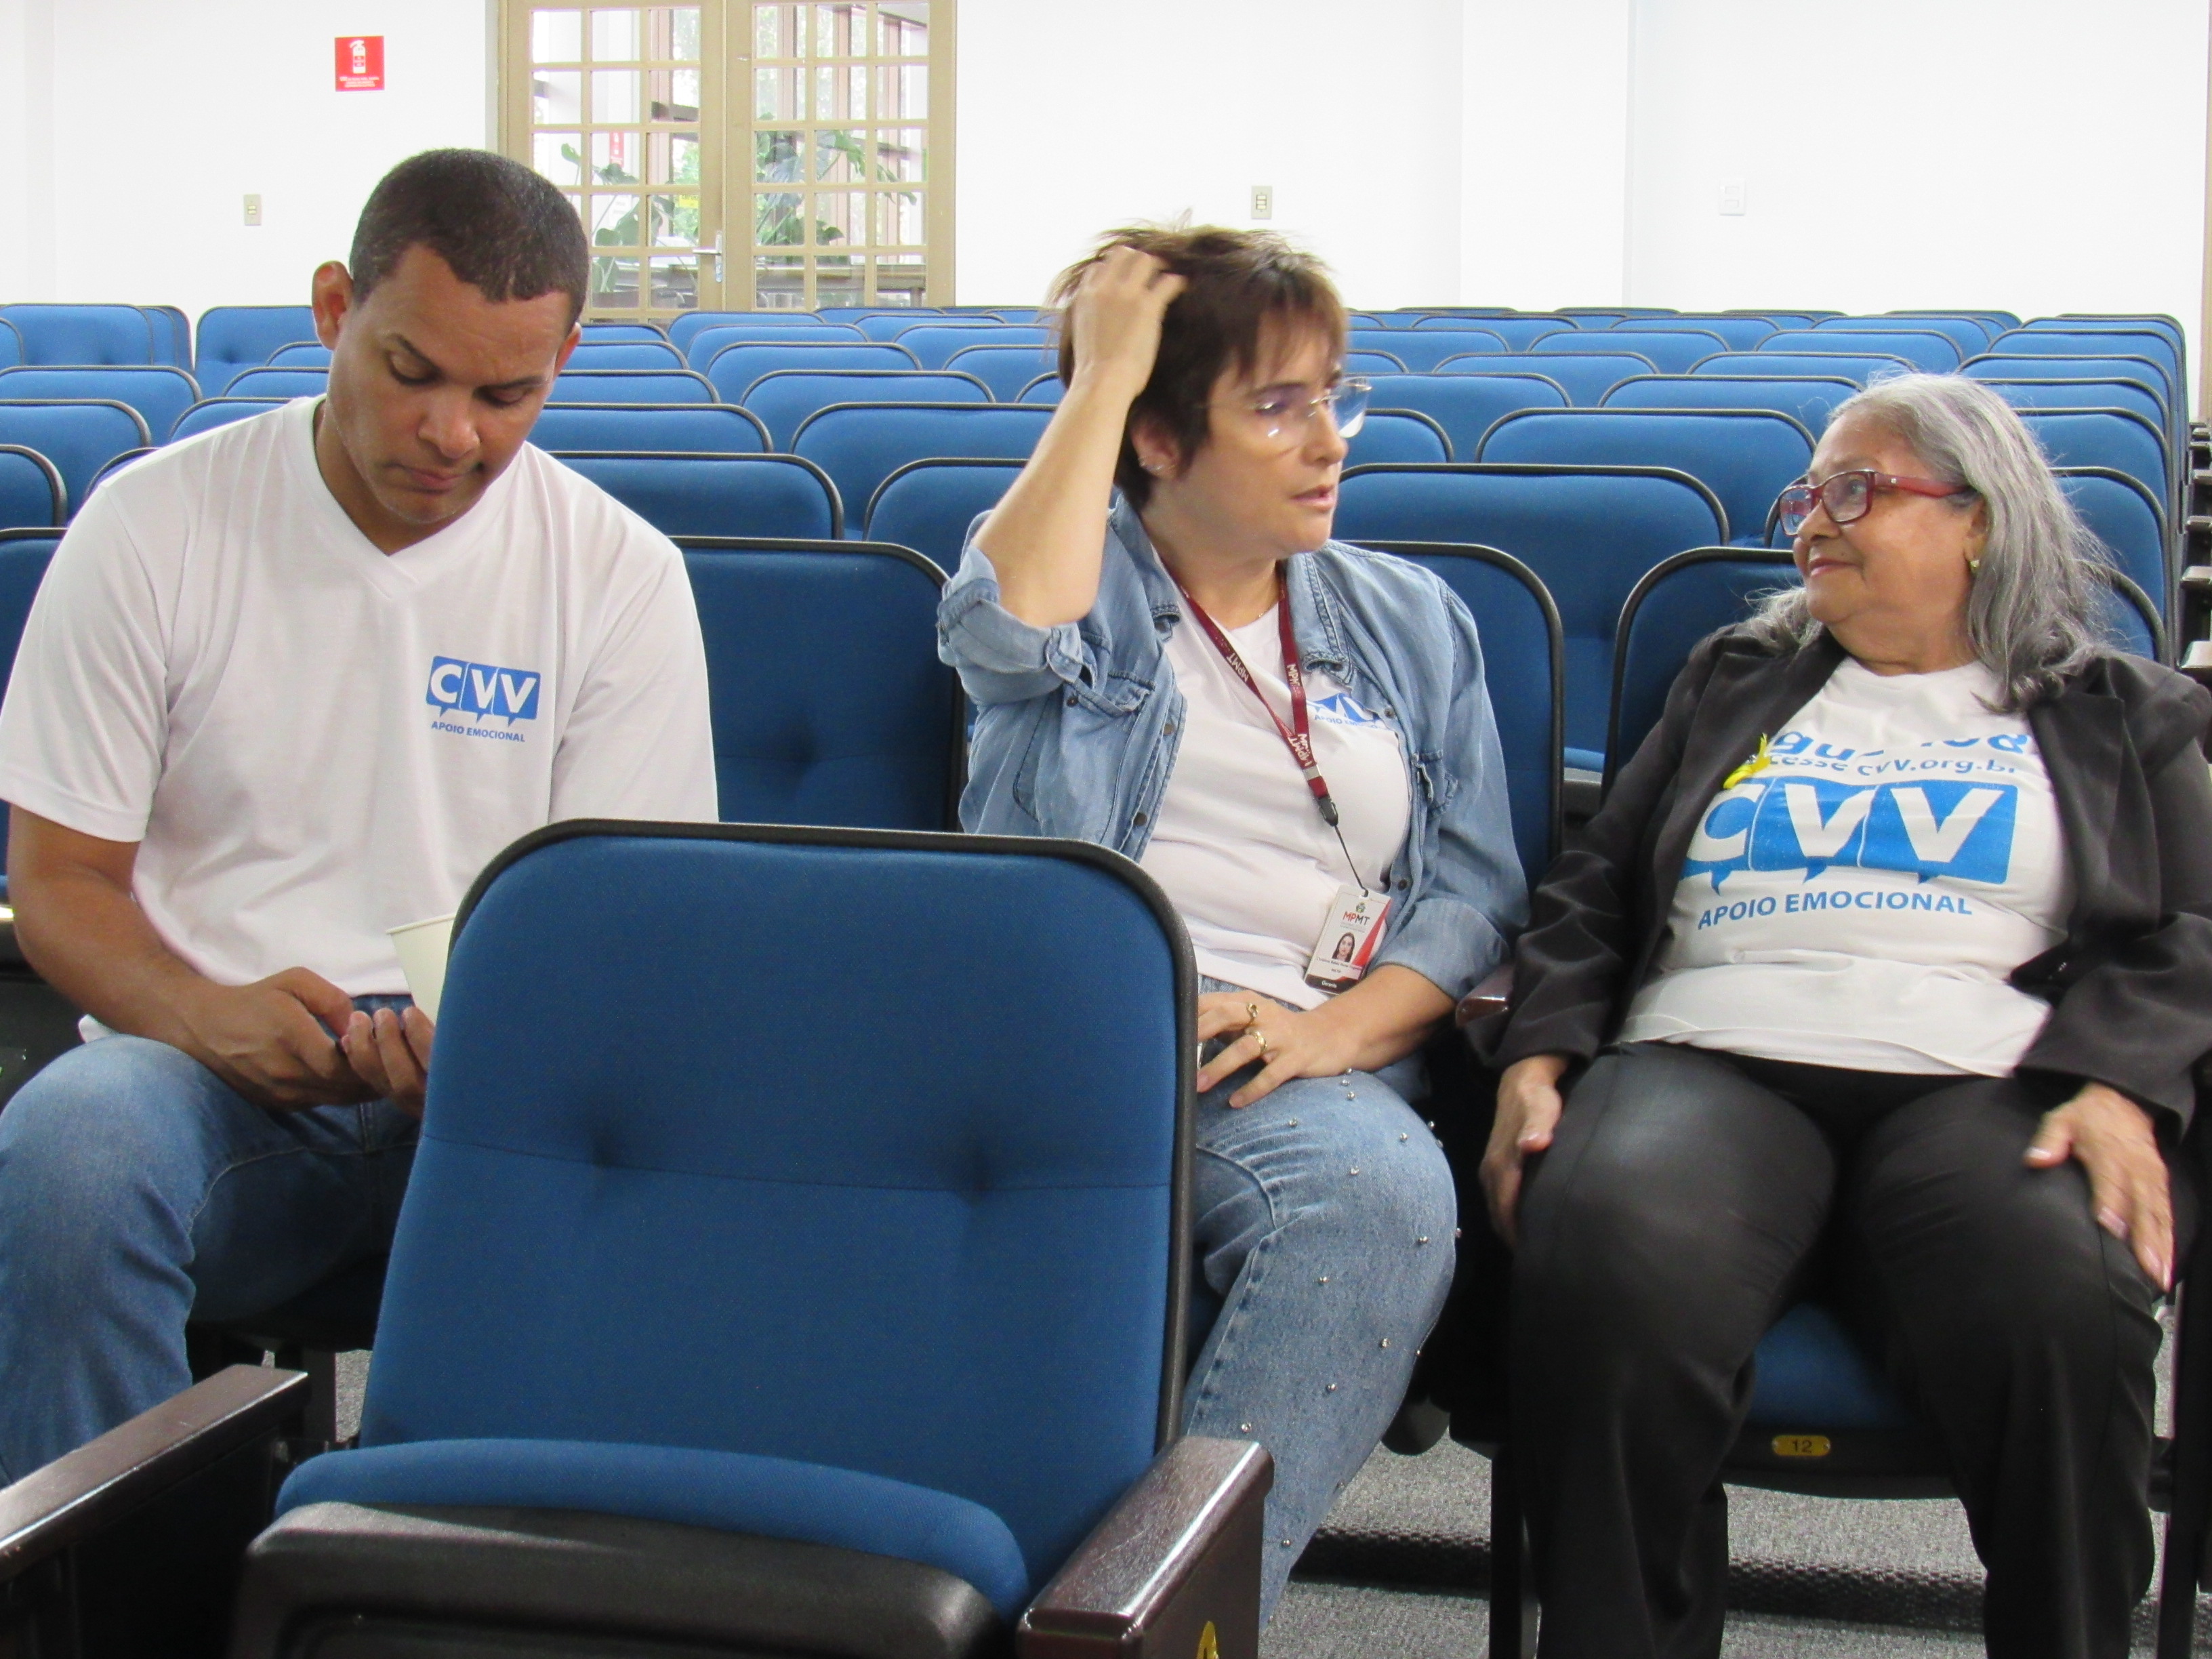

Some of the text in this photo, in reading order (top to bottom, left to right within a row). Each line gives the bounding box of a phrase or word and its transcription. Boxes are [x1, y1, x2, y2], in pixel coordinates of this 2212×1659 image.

[430, 663, 537, 714] CVV
[431, 721, 525, 743] APOIO EMOCIONAL
[1685, 783, 2006, 863] CVV
[1343, 911, 1370, 926] MPMT
[1698, 890, 1973, 930] APOIO EMOCIONAL
[1793, 1439, 1812, 1453] 12
